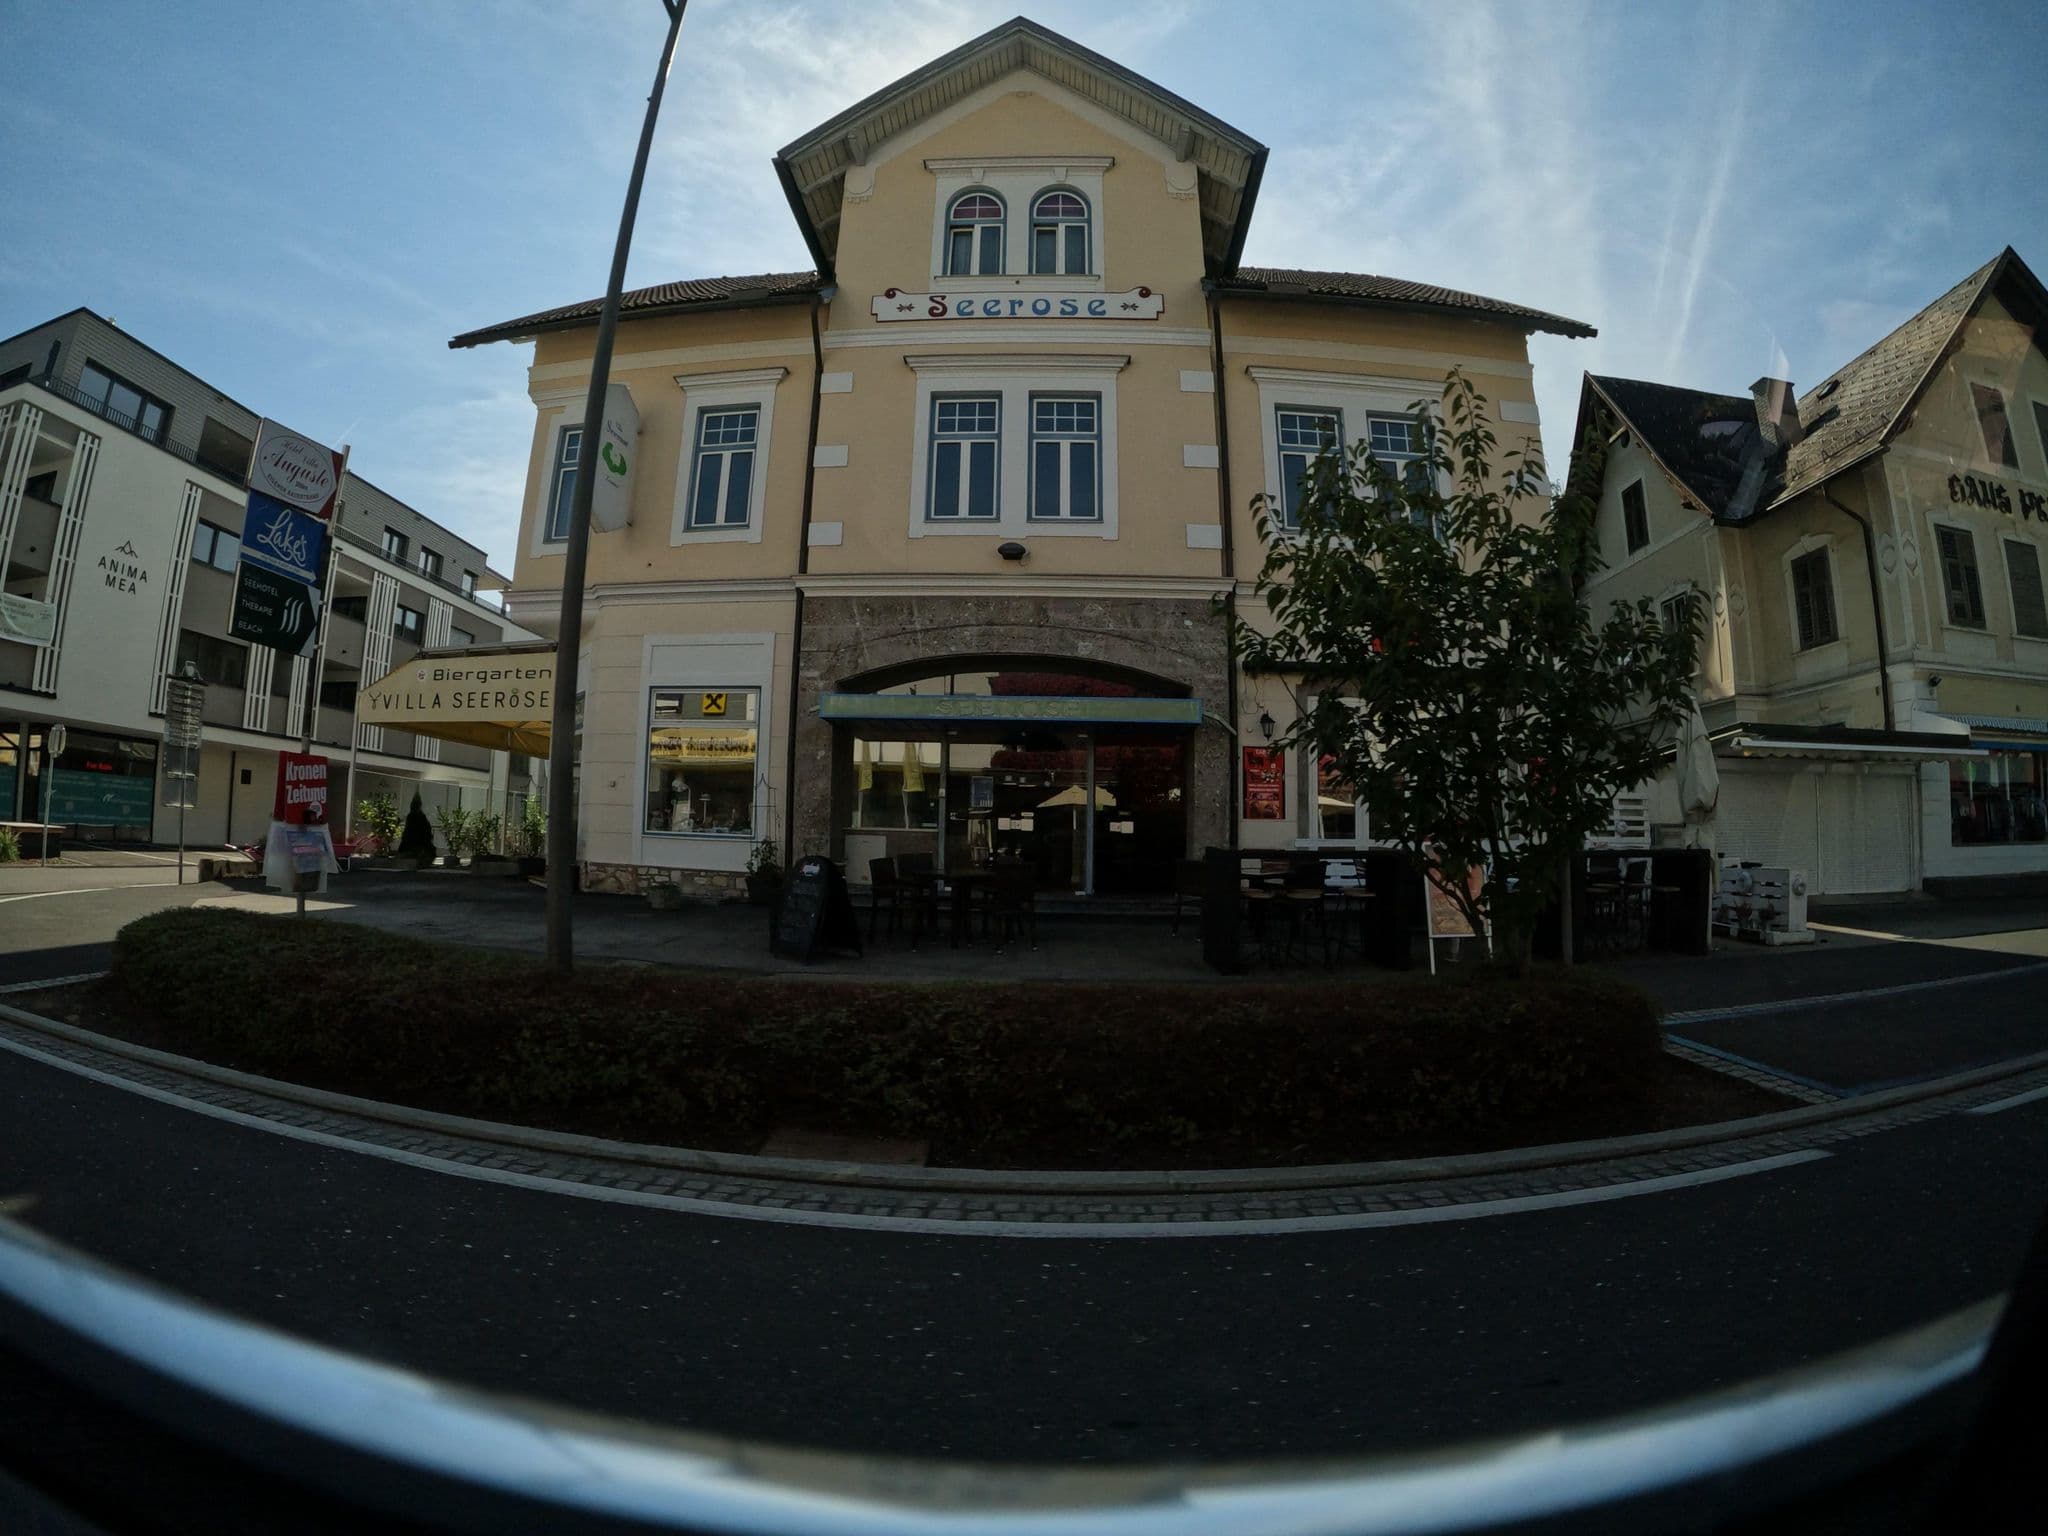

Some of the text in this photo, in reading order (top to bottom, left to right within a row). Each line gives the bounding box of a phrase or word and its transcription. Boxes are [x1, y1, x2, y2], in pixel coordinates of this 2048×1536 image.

[928, 295, 1107, 318] Seerose
[264, 450, 328, 487] Auguste
[256, 509, 308, 567] Lakes
[98, 556, 148, 583] ANIMA
[105, 574, 137, 595] MEA
[244, 577, 279, 596] SEEHOTEL
[238, 620, 263, 634] BEACH
[433, 668, 552, 684] Biergarten
[383, 692, 442, 710] VILLA
[286, 761, 327, 782] Kronen
[286, 784, 327, 804] Zeitung
